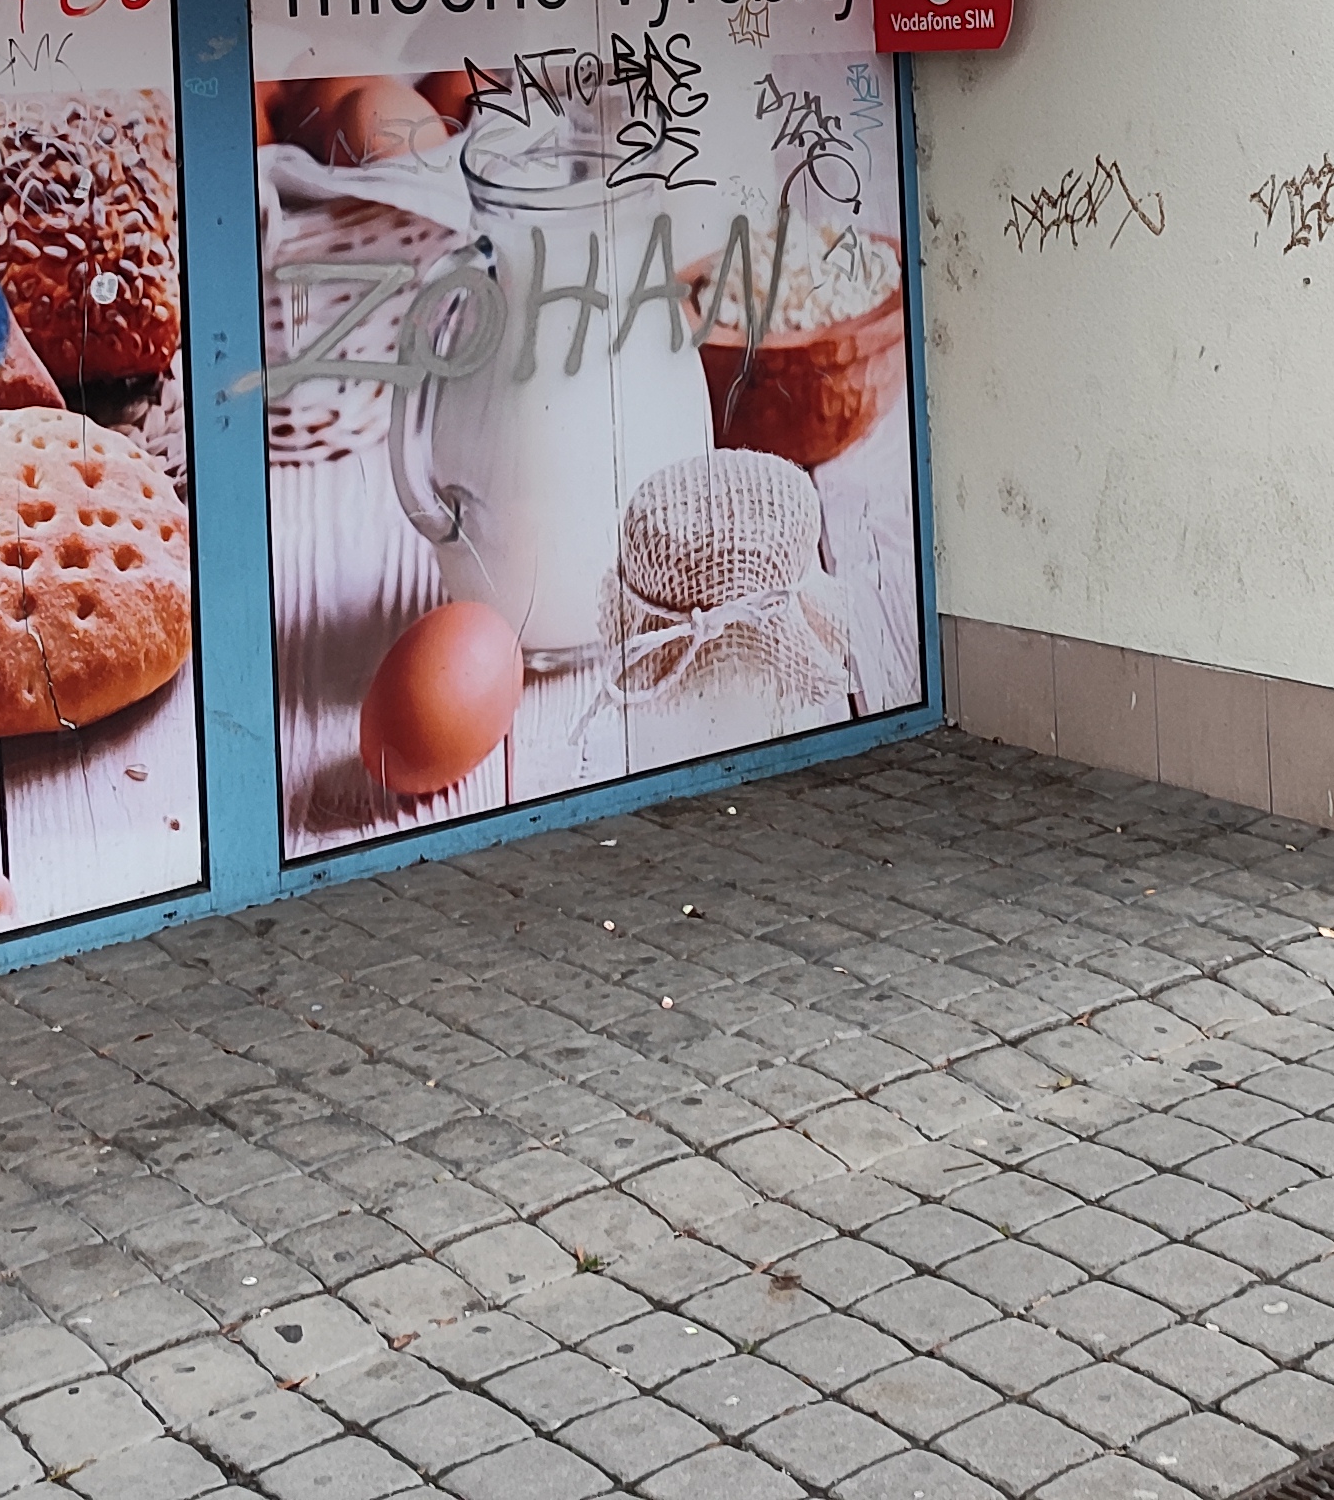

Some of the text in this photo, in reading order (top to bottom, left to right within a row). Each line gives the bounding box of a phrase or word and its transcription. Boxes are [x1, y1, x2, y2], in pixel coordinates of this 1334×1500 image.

[890, 8, 995, 33] Vodafone SIM
[233, 210, 790, 395] ZOHAN
